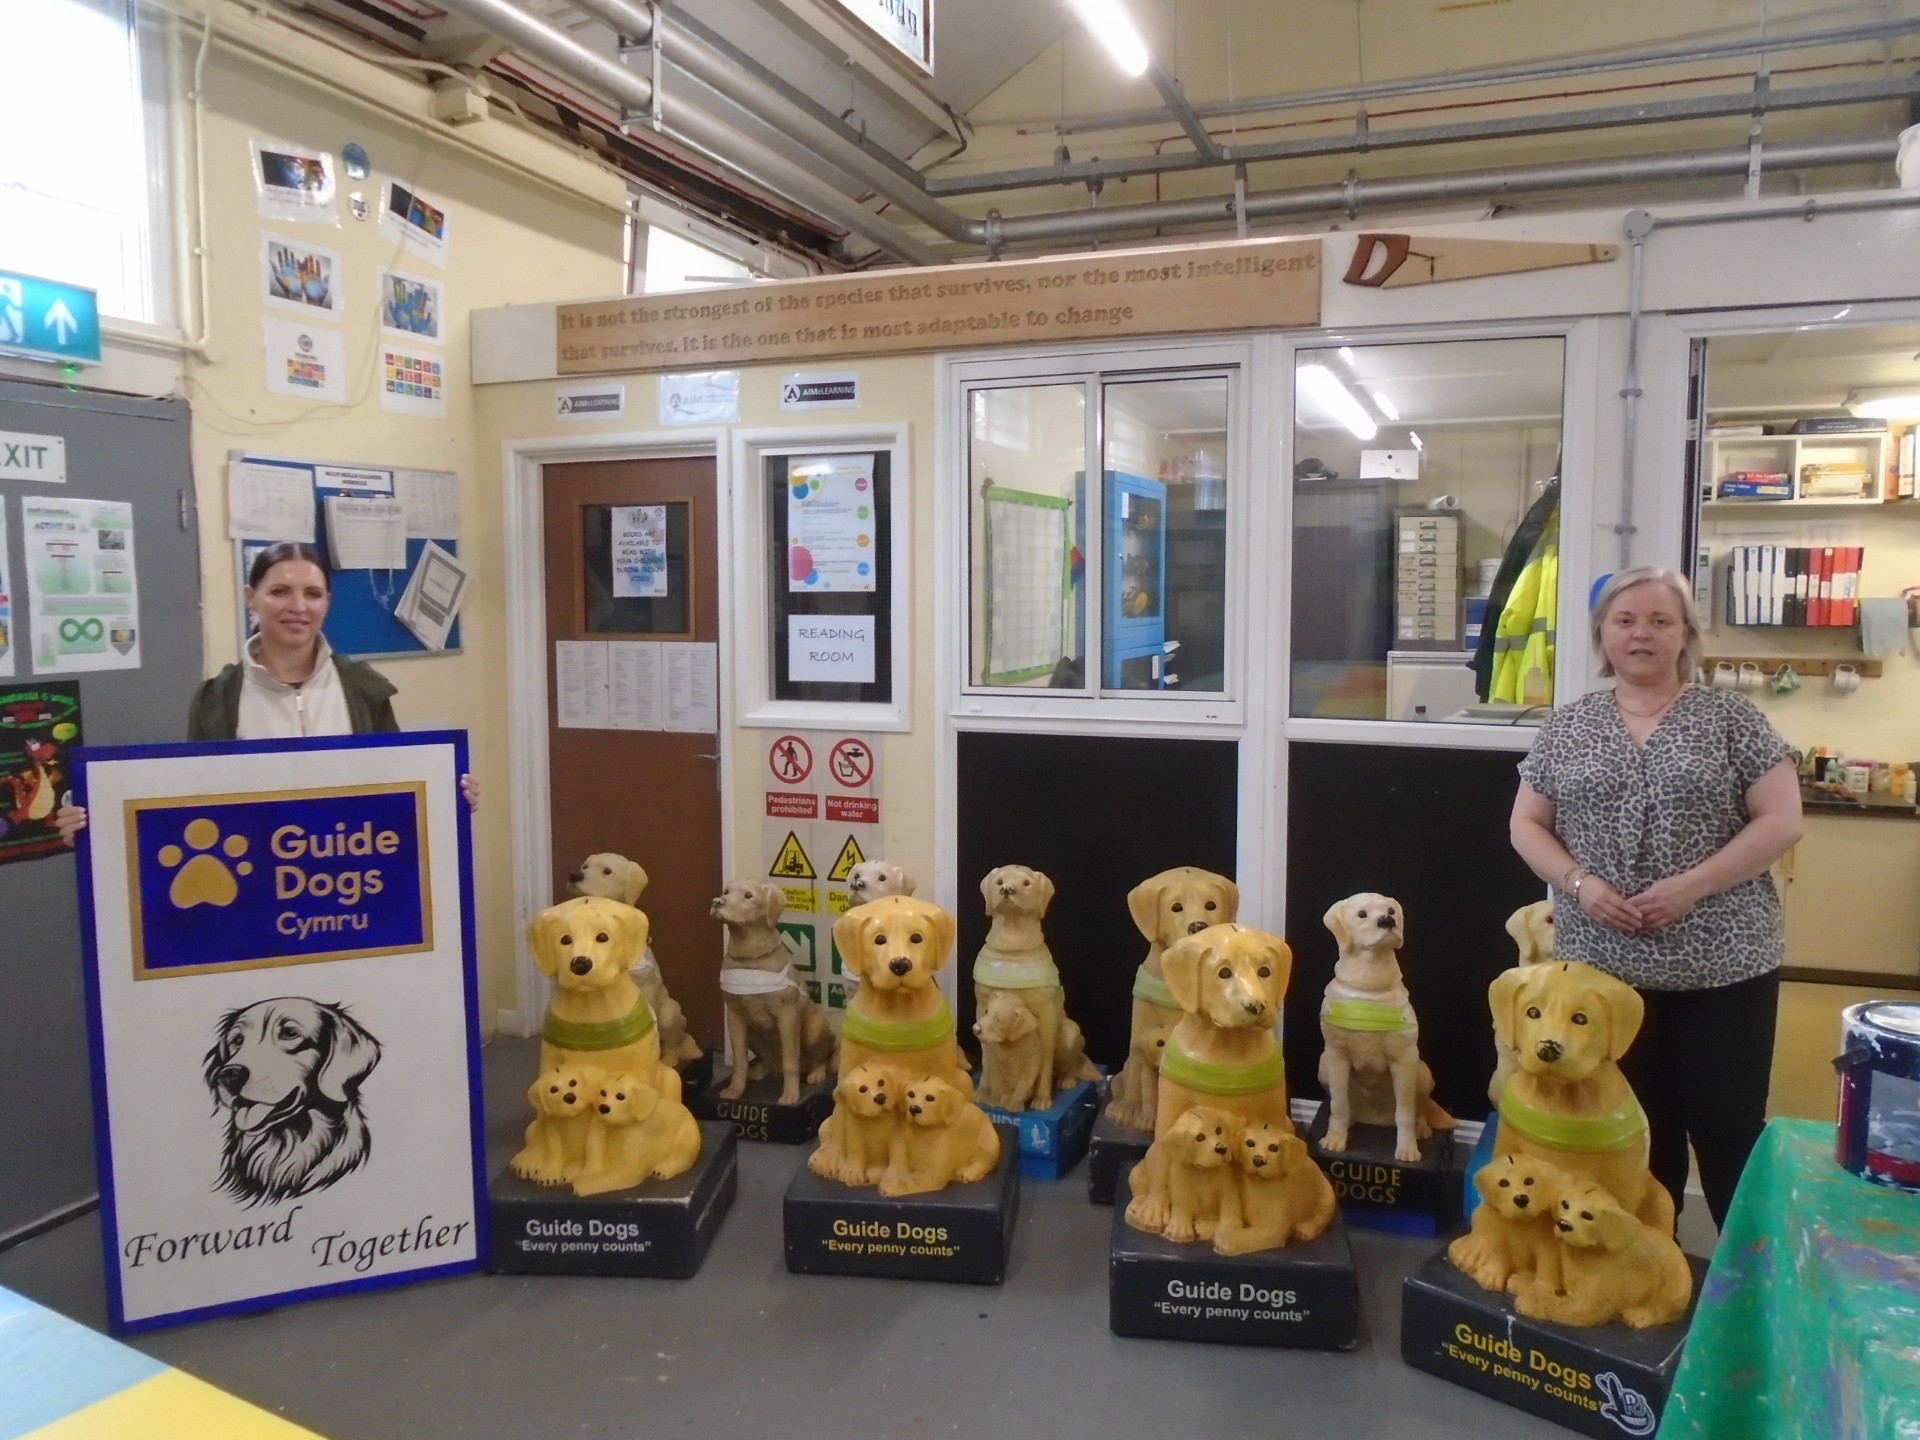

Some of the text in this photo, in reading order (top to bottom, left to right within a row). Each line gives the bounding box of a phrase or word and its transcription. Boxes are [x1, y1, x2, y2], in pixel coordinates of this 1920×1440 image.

[560, 253, 1316, 329] It is not the strongest of the species that survives, nor the most intelligent
[562, 345, 597, 361] that
[682, 336, 700, 352] It
[702, 335, 716, 350] is
[721, 332, 753, 349] the
[757, 333, 791, 346] one
[795, 326, 837, 342] that
[841, 324, 857, 340] is
[863, 320, 912, 338] most
[917, 311, 1020, 335] adaptable
[1026, 310, 1049, 326] to
[1055, 305, 1134, 325] change
[0, 443, 48, 469] XIT
[798, 628, 865, 642] READING
[809, 651, 854, 662] ROOM
[768, 795, 816, 806] Pedestrians
[771, 804, 813, 815] prohibited
[827, 800, 877, 812] Not drinking
[841, 810, 863, 818] water
[270, 821, 400, 860] Guide
[275, 865, 384, 905] Dogs
[276, 911, 369, 940] Cymru
[717, 1102, 768, 1123] GUIDE
[736, 1123, 768, 1141] OGS
[1330, 1161, 1401, 1186] GUIDE
[1335, 1180, 1396, 1204] DOGS
[124, 1205, 470, 1272] Forward Together
[525, 1219, 639, 1240] Guide Dogs
[833, 1219, 948, 1244] Guide Dogs
[561, 1242, 598, 1254] penny
[867, 1242, 906, 1256] penny
[1167, 1279, 1297, 1308] Guide Dogs
[1205, 1306, 1249, 1321] penny
[1454, 1323, 1592, 1390] Guide Dogs
[1493, 1363, 1540, 1391] penny
